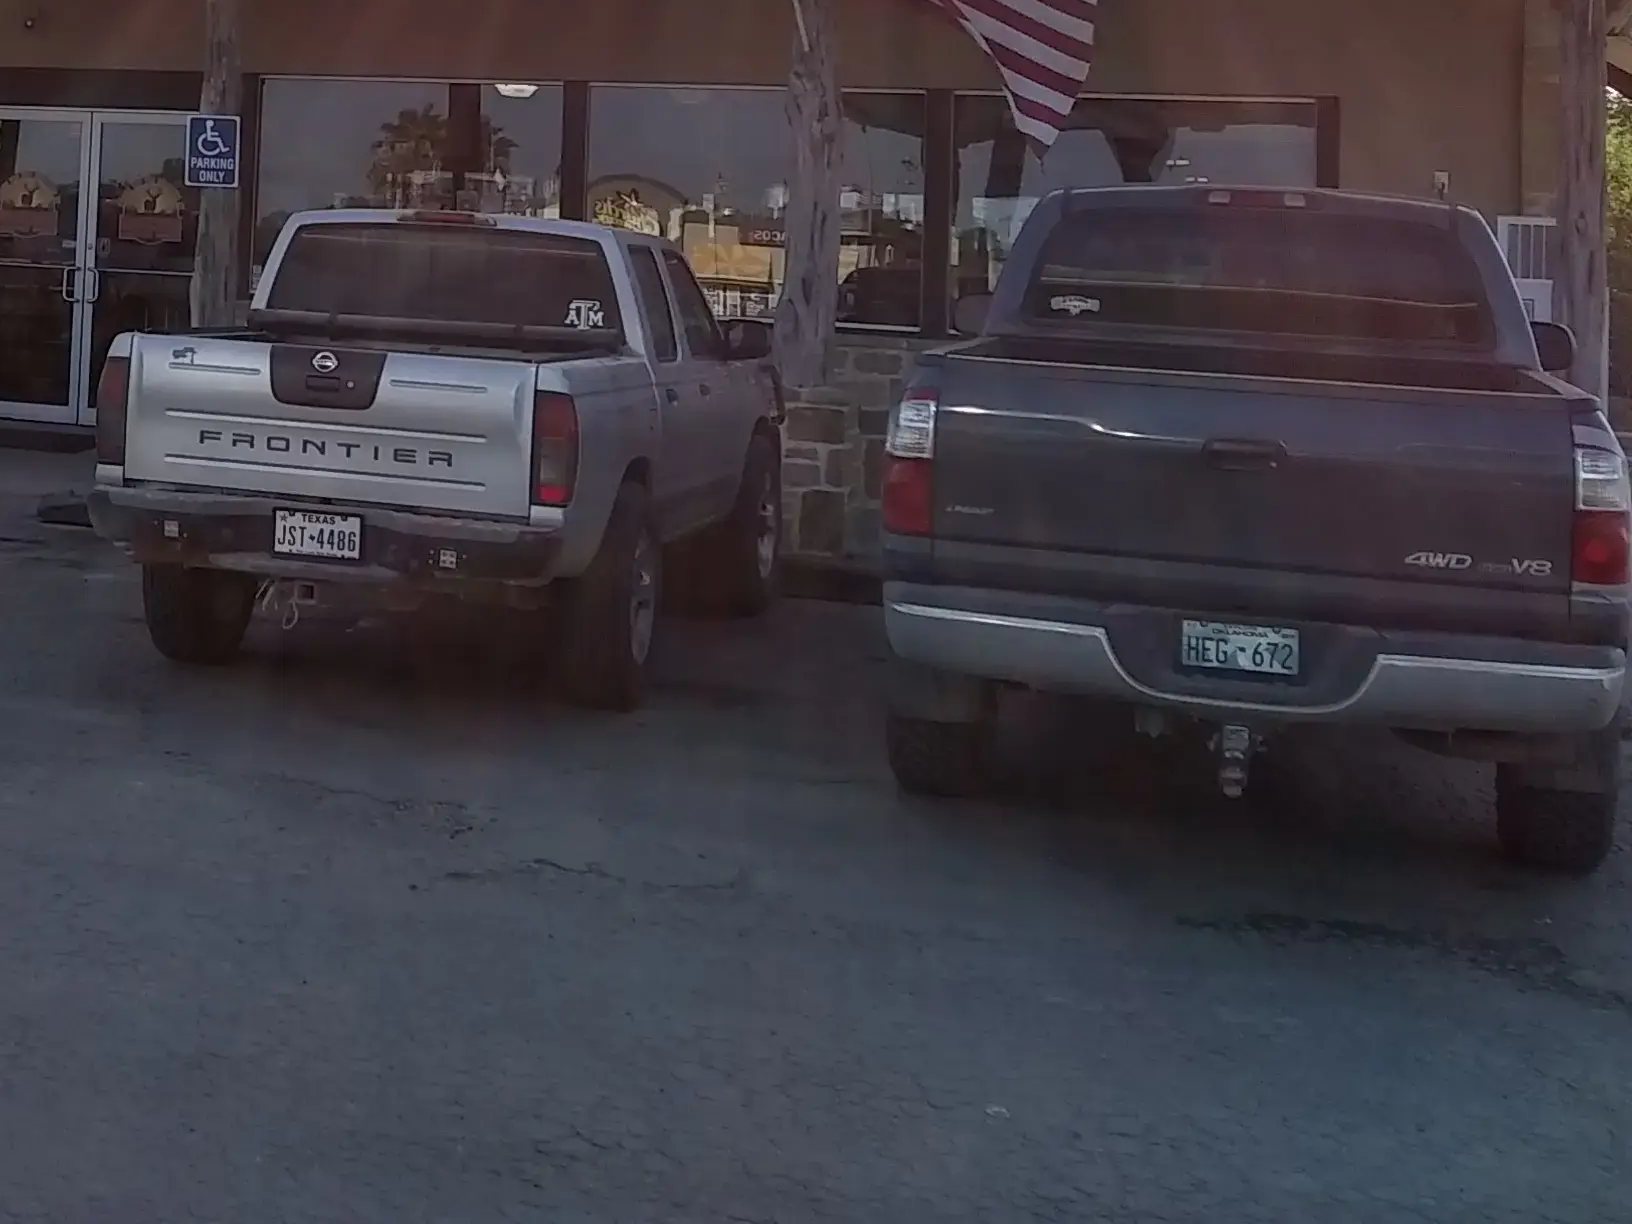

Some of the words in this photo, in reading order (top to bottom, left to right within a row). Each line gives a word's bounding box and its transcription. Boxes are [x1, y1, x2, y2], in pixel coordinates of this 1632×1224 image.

[190, 156, 235, 170] PARKING
[199, 170, 225, 183] ONLY
[199, 429, 453, 468] FRONTIER
[301, 513, 336, 525] TEXAS
[1404, 551, 1473, 570] 4WD
[1511, 557, 1553, 577] V8
